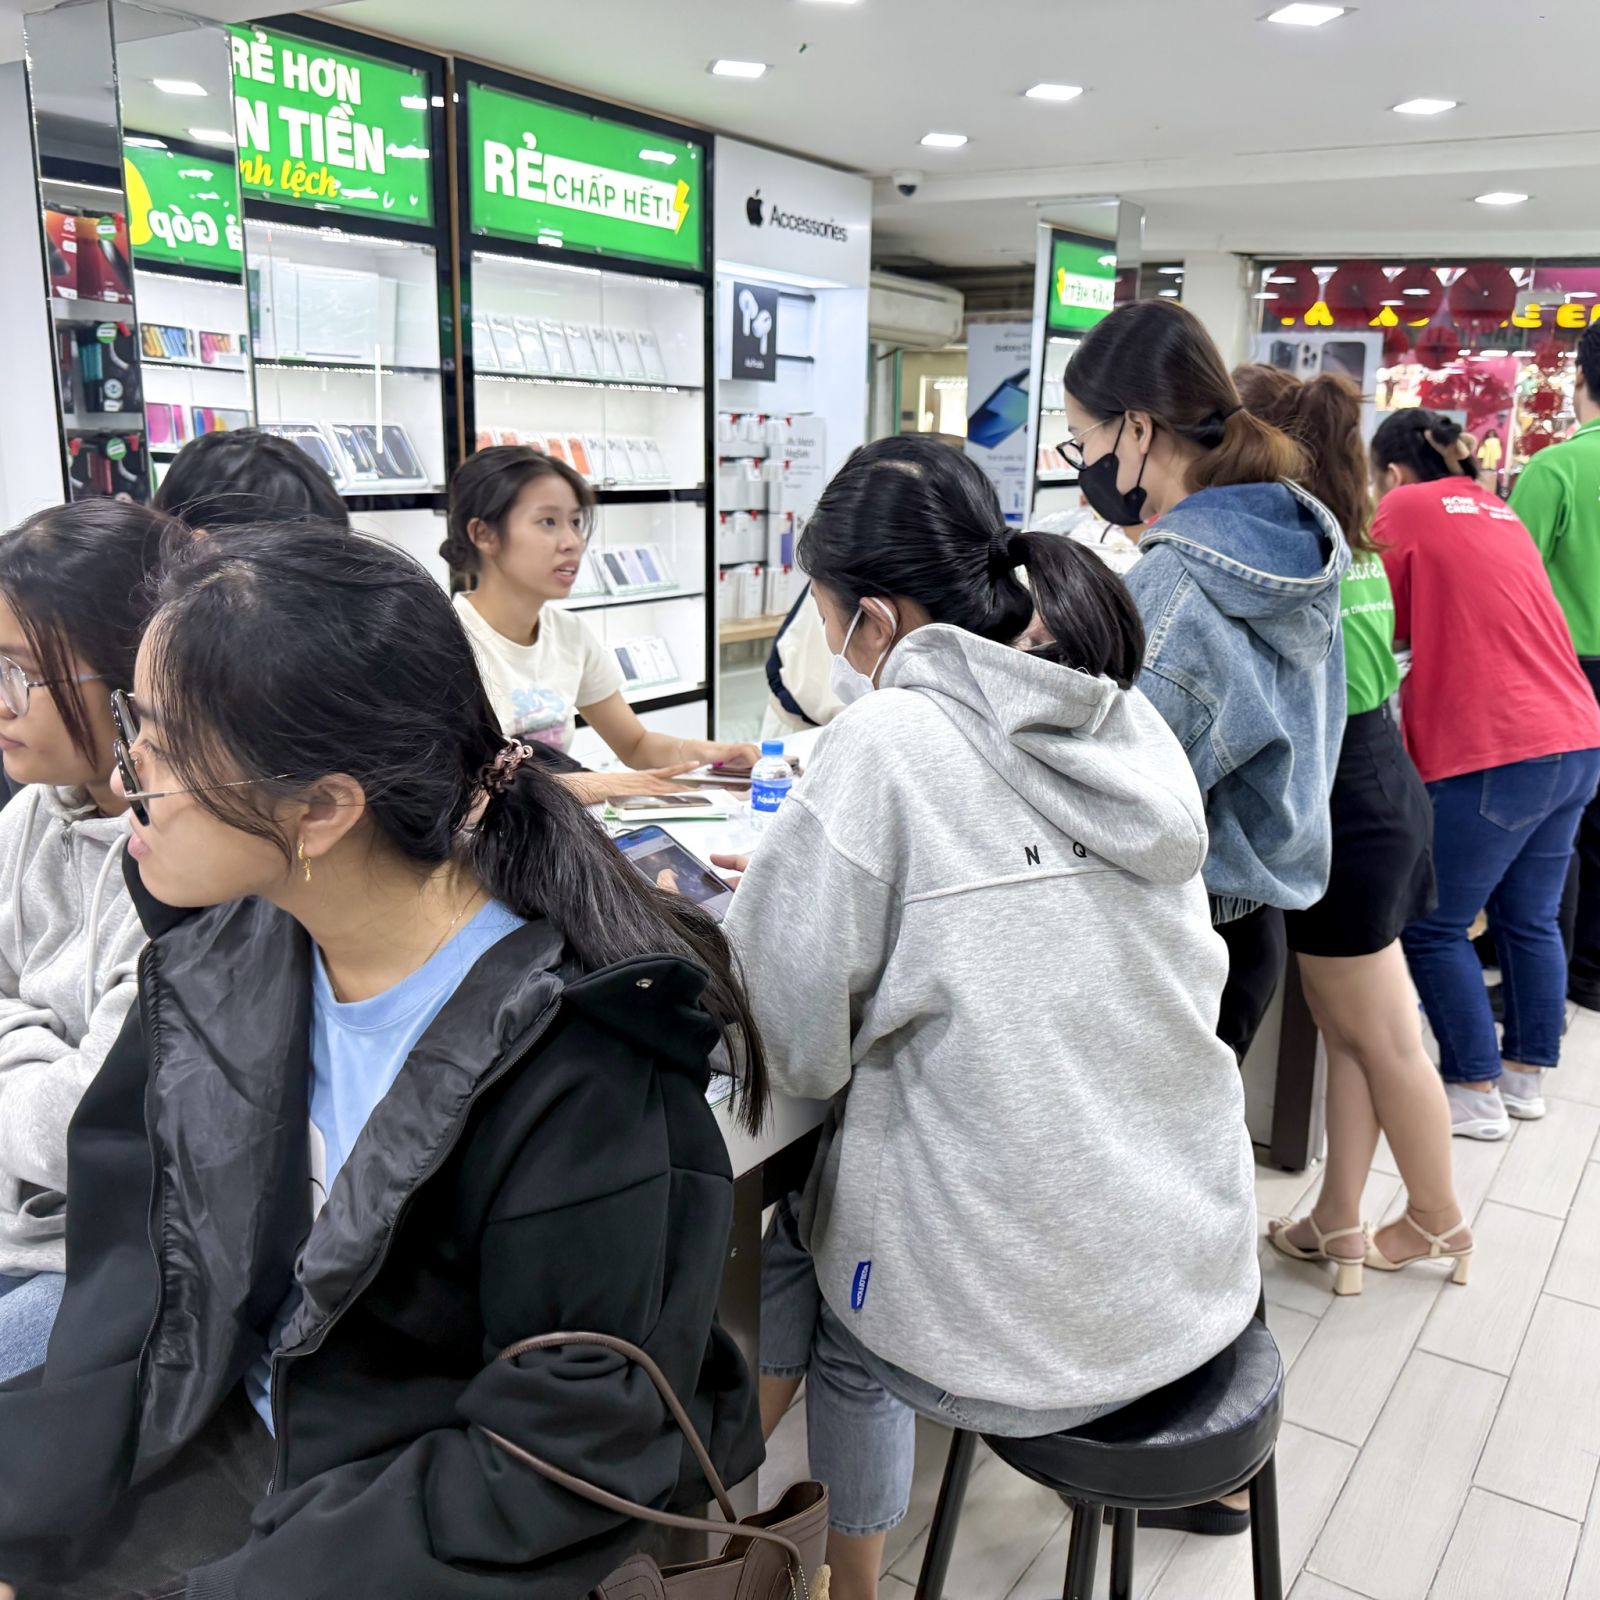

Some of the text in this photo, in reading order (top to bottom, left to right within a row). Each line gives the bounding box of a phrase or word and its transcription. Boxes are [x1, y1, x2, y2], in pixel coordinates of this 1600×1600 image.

[231, 31, 362, 105] RẺ HƠN
[234, 96, 386, 175] N TIỀN
[280, 159, 338, 198] lệch
[484, 132, 671, 222] RẺ CHẤP HẾT!
[769, 204, 849, 243] Accessories
[1024, 841, 1088, 866] N Q
